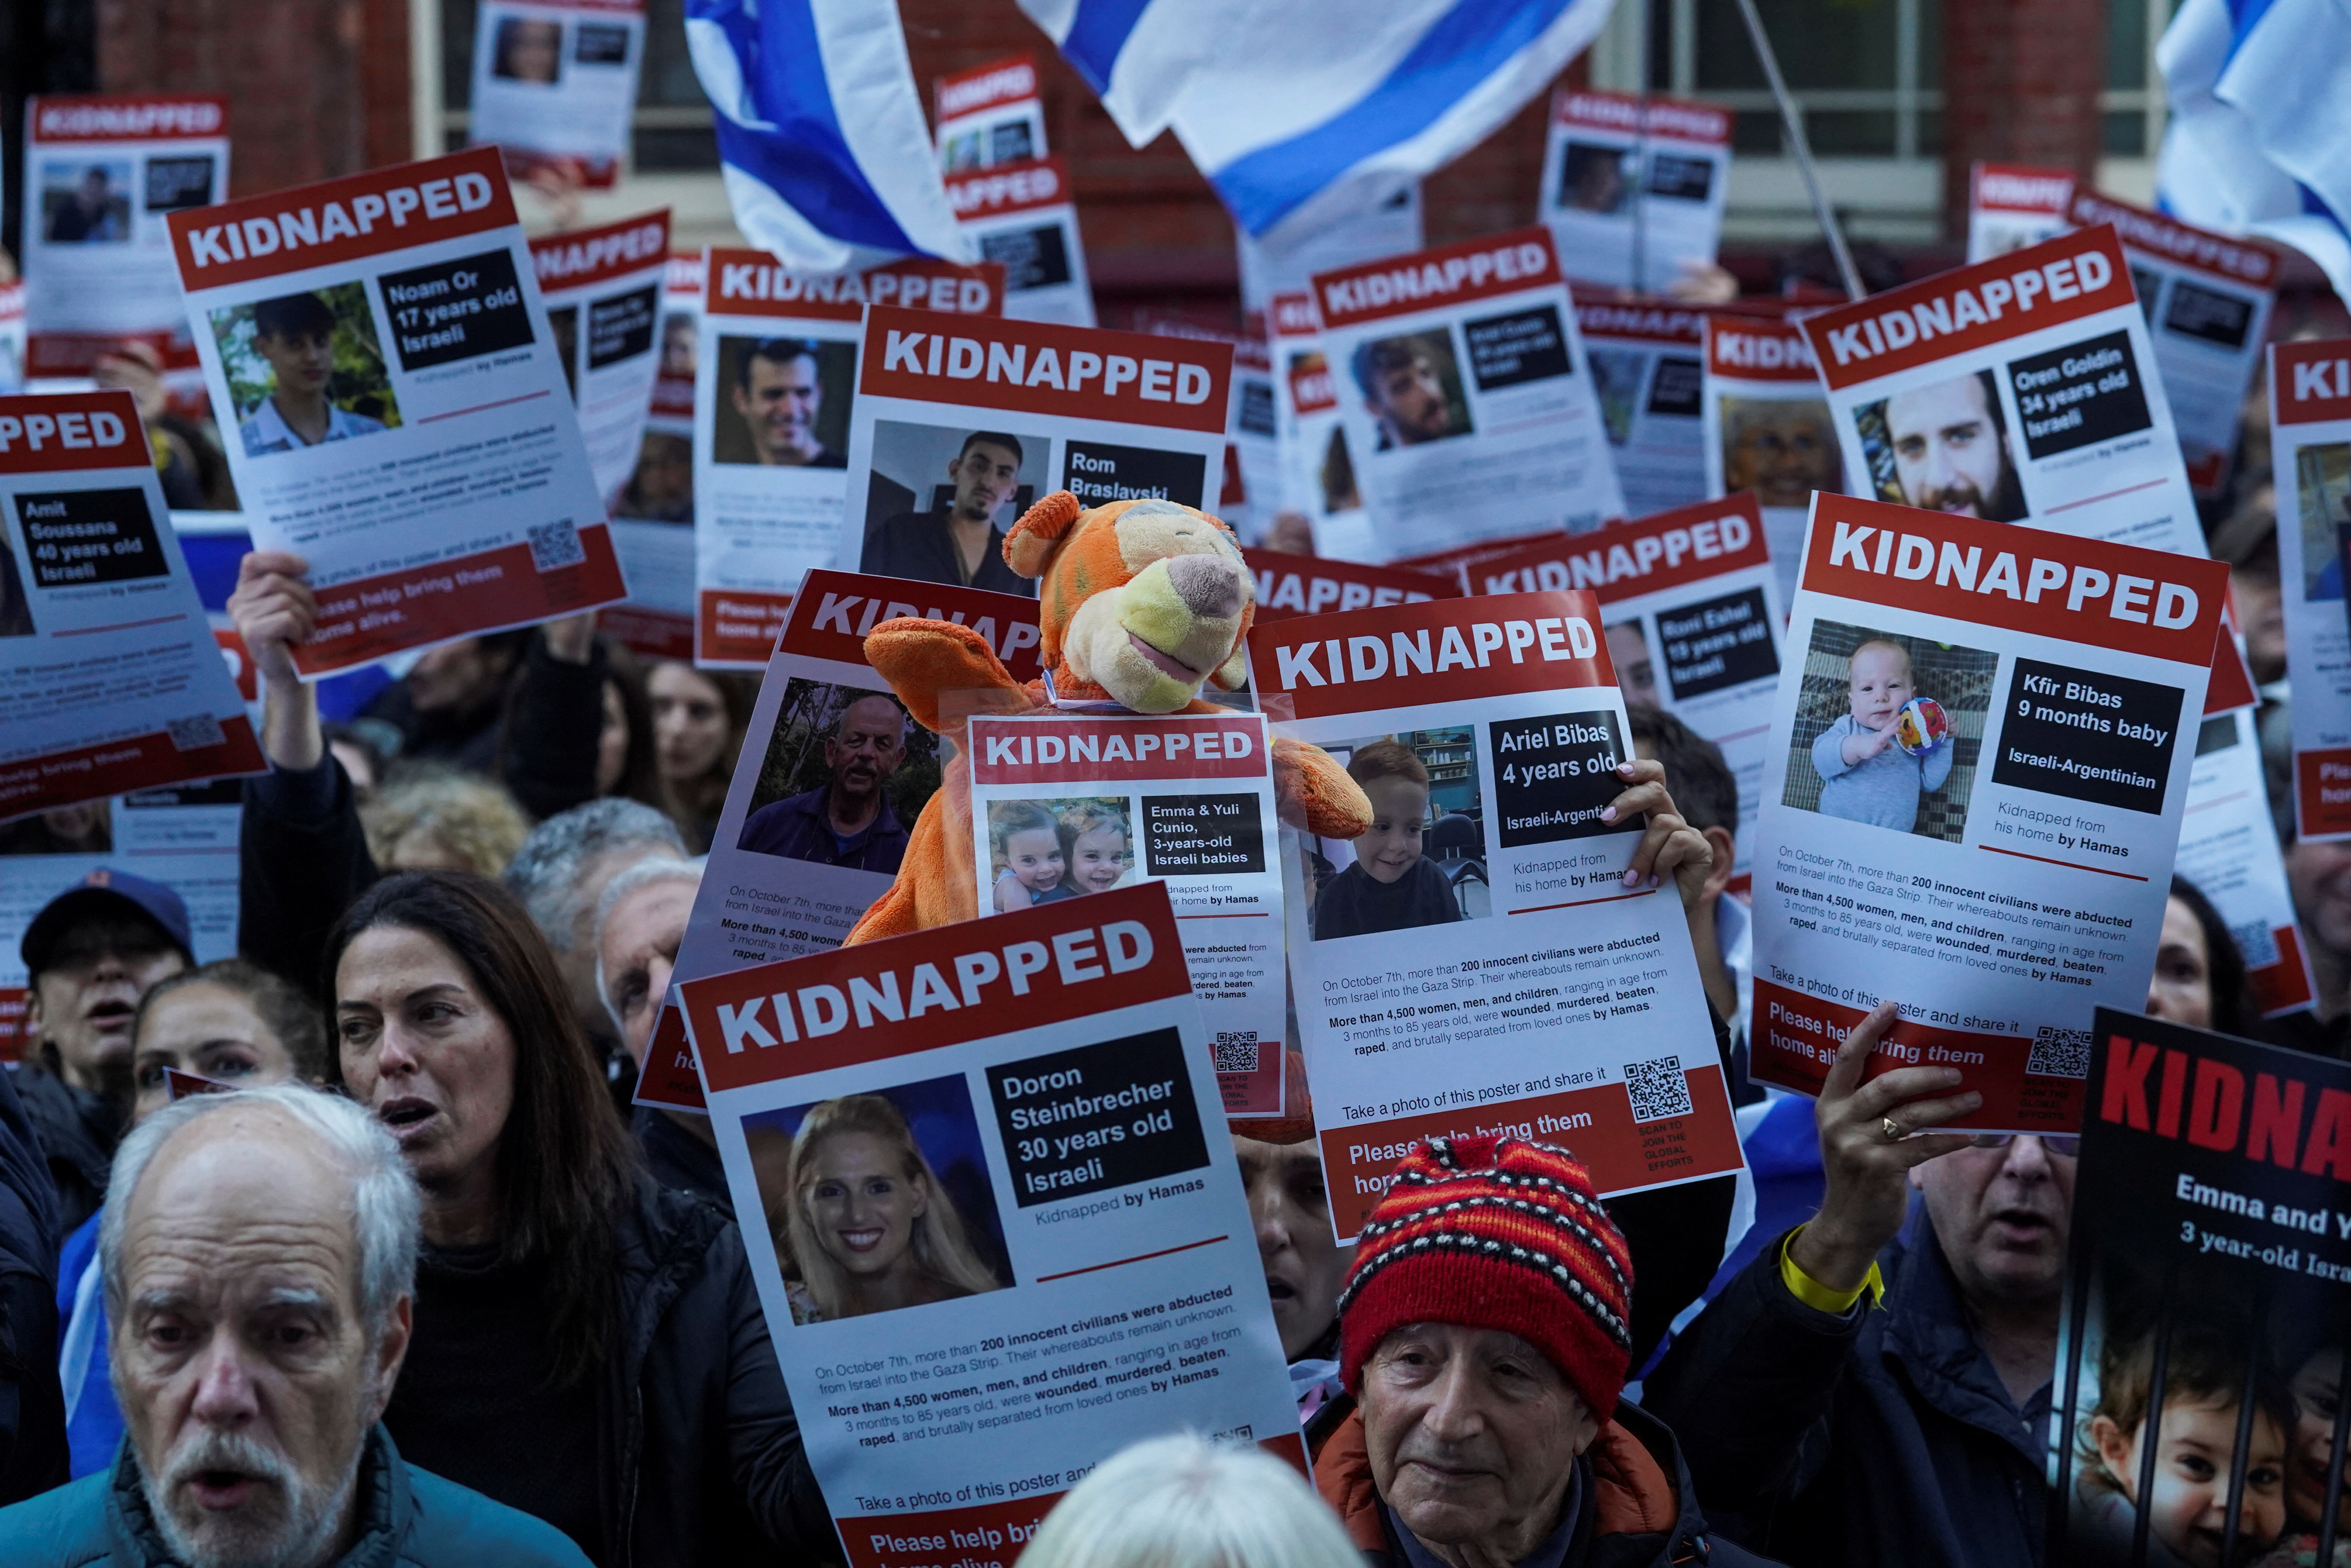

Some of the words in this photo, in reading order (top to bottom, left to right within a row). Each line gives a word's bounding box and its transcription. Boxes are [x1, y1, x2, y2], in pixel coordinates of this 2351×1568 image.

[188, 172, 492, 267] KIDNAPPED
[389, 279, 450, 304] Noam
[452, 271, 477, 290] Or
[722, 264, 990, 314] KIDNAPPED
[1326, 242, 1547, 315] KIDNAPPED
[396, 307, 419, 328] 17
[424, 298, 481, 327] years
[484, 285, 518, 309] old
[1827, 251, 2112, 366] KIDNAPPED
[402, 324, 465, 353] Israeli
[884, 330, 1211, 405] KIDNAPPED
[2015, 368, 2060, 391] Oren
[2062, 348, 2122, 379] Goldin
[2022, 396, 2044, 415] 34
[2047, 383, 2095, 412] years
[2098, 369, 2129, 393] old
[2026, 408, 2083, 439] Israeli
[1072, 453, 1115, 473] Rom
[1070, 478, 1167, 500] Braslavski
[26, 501, 67, 518] Amit
[29, 521, 118, 539] Soussana
[36, 543, 57, 560] 40
[61, 543, 110, 562] years
[113, 537, 144, 554] old
[1485, 515, 1751, 595] KIDNAPPED
[40, 562, 96, 581] Israeli
[359, 588, 402, 607] help
[403, 576, 454, 598] bring
[455, 565, 503, 586] them
[1829, 521, 2198, 630] KIDNAPPED
[1276, 617, 1597, 690] KIDNAPPED
[1691, 636, 1738, 659] years
[1739, 619, 1767, 642] old
[1670, 655, 1725, 683] Israeli
[2023, 674, 2061, 696] Kfir
[2065, 682, 2122, 708] Bibas
[1500, 727, 1549, 753] Ariel
[1555, 724, 1609, 745] Bibas
[2018, 700, 2030, 716] 9
[2035, 706, 2111, 733] months
[2117, 718, 2168, 747] baby
[986, 732, 1252, 765] KIDNAPPED
[1503, 763, 1516, 783] 4
[1521, 760, 1580, 787] years
[1586, 752, 1616, 773] old
[2009, 747, 2156, 789] Israeli-Argentinian
[1151, 806, 1195, 817] Emma
[1199, 805, 1210, 815] &
[1213, 803, 1239, 815] Yuli
[1507, 805, 1609, 830] Israeli-Argenti
[1998, 801, 2071, 827] Kidnapped
[2076, 817, 2105, 833] from
[1152, 822, 1197, 833] Cunio,
[1154, 835, 1231, 851] 3-years-old
[1995, 820, 2012, 834] his
[2017, 824, 2053, 842] home
[2058, 833, 2075, 849] by
[2080, 837, 2128, 857] Hamas
[1155, 853, 1197, 865] Israeli
[1201, 852, 1248, 864] babies
[1514, 856, 1577, 875] Kidnapped
[1580, 854, 1606, 865] from
[730, 885, 745, 896] On
[748, 888, 791, 905] October
[794, 897, 812, 909] 7th,
[816, 902, 842, 912] more
[1168, 885, 1208, 894] dnapped
[1210, 896, 1222, 906] by
[1515, 881, 1532, 893] his
[1535, 878, 1567, 890] home
[1570, 875, 1585, 888] by
[1208, 944, 1246, 953] abducted
[1323, 980, 1338, 991] On
[1341, 976, 1382, 988] October
[1385, 971, 1405, 982] 7th,
[1408, 969, 1433, 979] more
[1436, 965, 1458, 975] than
[1461, 960, 1479, 971] 200
[1482, 953, 1529, 968] innocent
[1532, 948, 1575, 962] civilians
[1578, 944, 1604, 954] were
[1607, 932, 1660, 950] abducted
[716, 920, 1154, 1054] KIDNAPPED
[1770, 965, 1794, 984] Take
[1797, 977, 1804, 987] a
[1807, 979, 1838, 997] photo
[1841, 988, 1854, 1001] of
[1857, 991, 1879, 1007] this
[1894, 1002, 1927, 1018] oster
[1930, 1011, 1959, 1024] and
[1963, 1015, 2005, 1031] share
[2010, 1021, 2019, 1033] it
[1770, 1001, 1822, 1034] Please
[1827, 1020, 1851, 1048] hel
[1928, 1045, 1984, 1064] them
[1770, 1029, 1815, 1058] home
[1818, 1048, 1835, 1065] ali
[1002, 1068, 1082, 1099] Doron
[1342, 1105, 1375, 1120] Take
[1379, 1104, 1388, 1115] a
[1392, 1097, 1429, 1116] photo
[1434, 1091, 1446, 1106] of
[1450, 1088, 1475, 1103] this
[1478, 1083, 1520, 1103] poster
[1525, 1076, 1550, 1092] and
[1555, 1072, 1593, 1087] share
[1597, 1067, 1606, 1080] it
[1011, 1080, 1173, 1130] Steinbrecher
[1018, 1137, 1048, 1162] 30
[1054, 1125, 1125, 1159] years
[1132, 1109, 1173, 1136] old
[1537, 1112, 1592, 1134] them
[1638, 1123, 1667, 1136] SCAN
[1668, 1120, 1682, 1130] TO
[1642, 1136, 1665, 1148] JOIN
[1666, 1132, 1686, 1143] THE
[1644, 1145, 1687, 1159] GLOBAL
[1647, 1155, 1694, 1171] EFFORTS
[1025, 1157, 1103, 1193] Israeli
[1035, 1197, 1120, 1225] Kidnapped
[1123, 1193, 1143, 1207] by
[1148, 1179, 1204, 1200] Hamas
[2176, 1172, 2265, 1220] Emma
[2271, 1204, 2328, 1235] and
[2180, 1221, 2195, 1243] 3
[2199, 1231, 2299, 1271] year-old
[870, 1534, 946, 1553] Please
[950, 1527, 1002, 1550] help
[1007, 1518, 1038, 1543] bri
